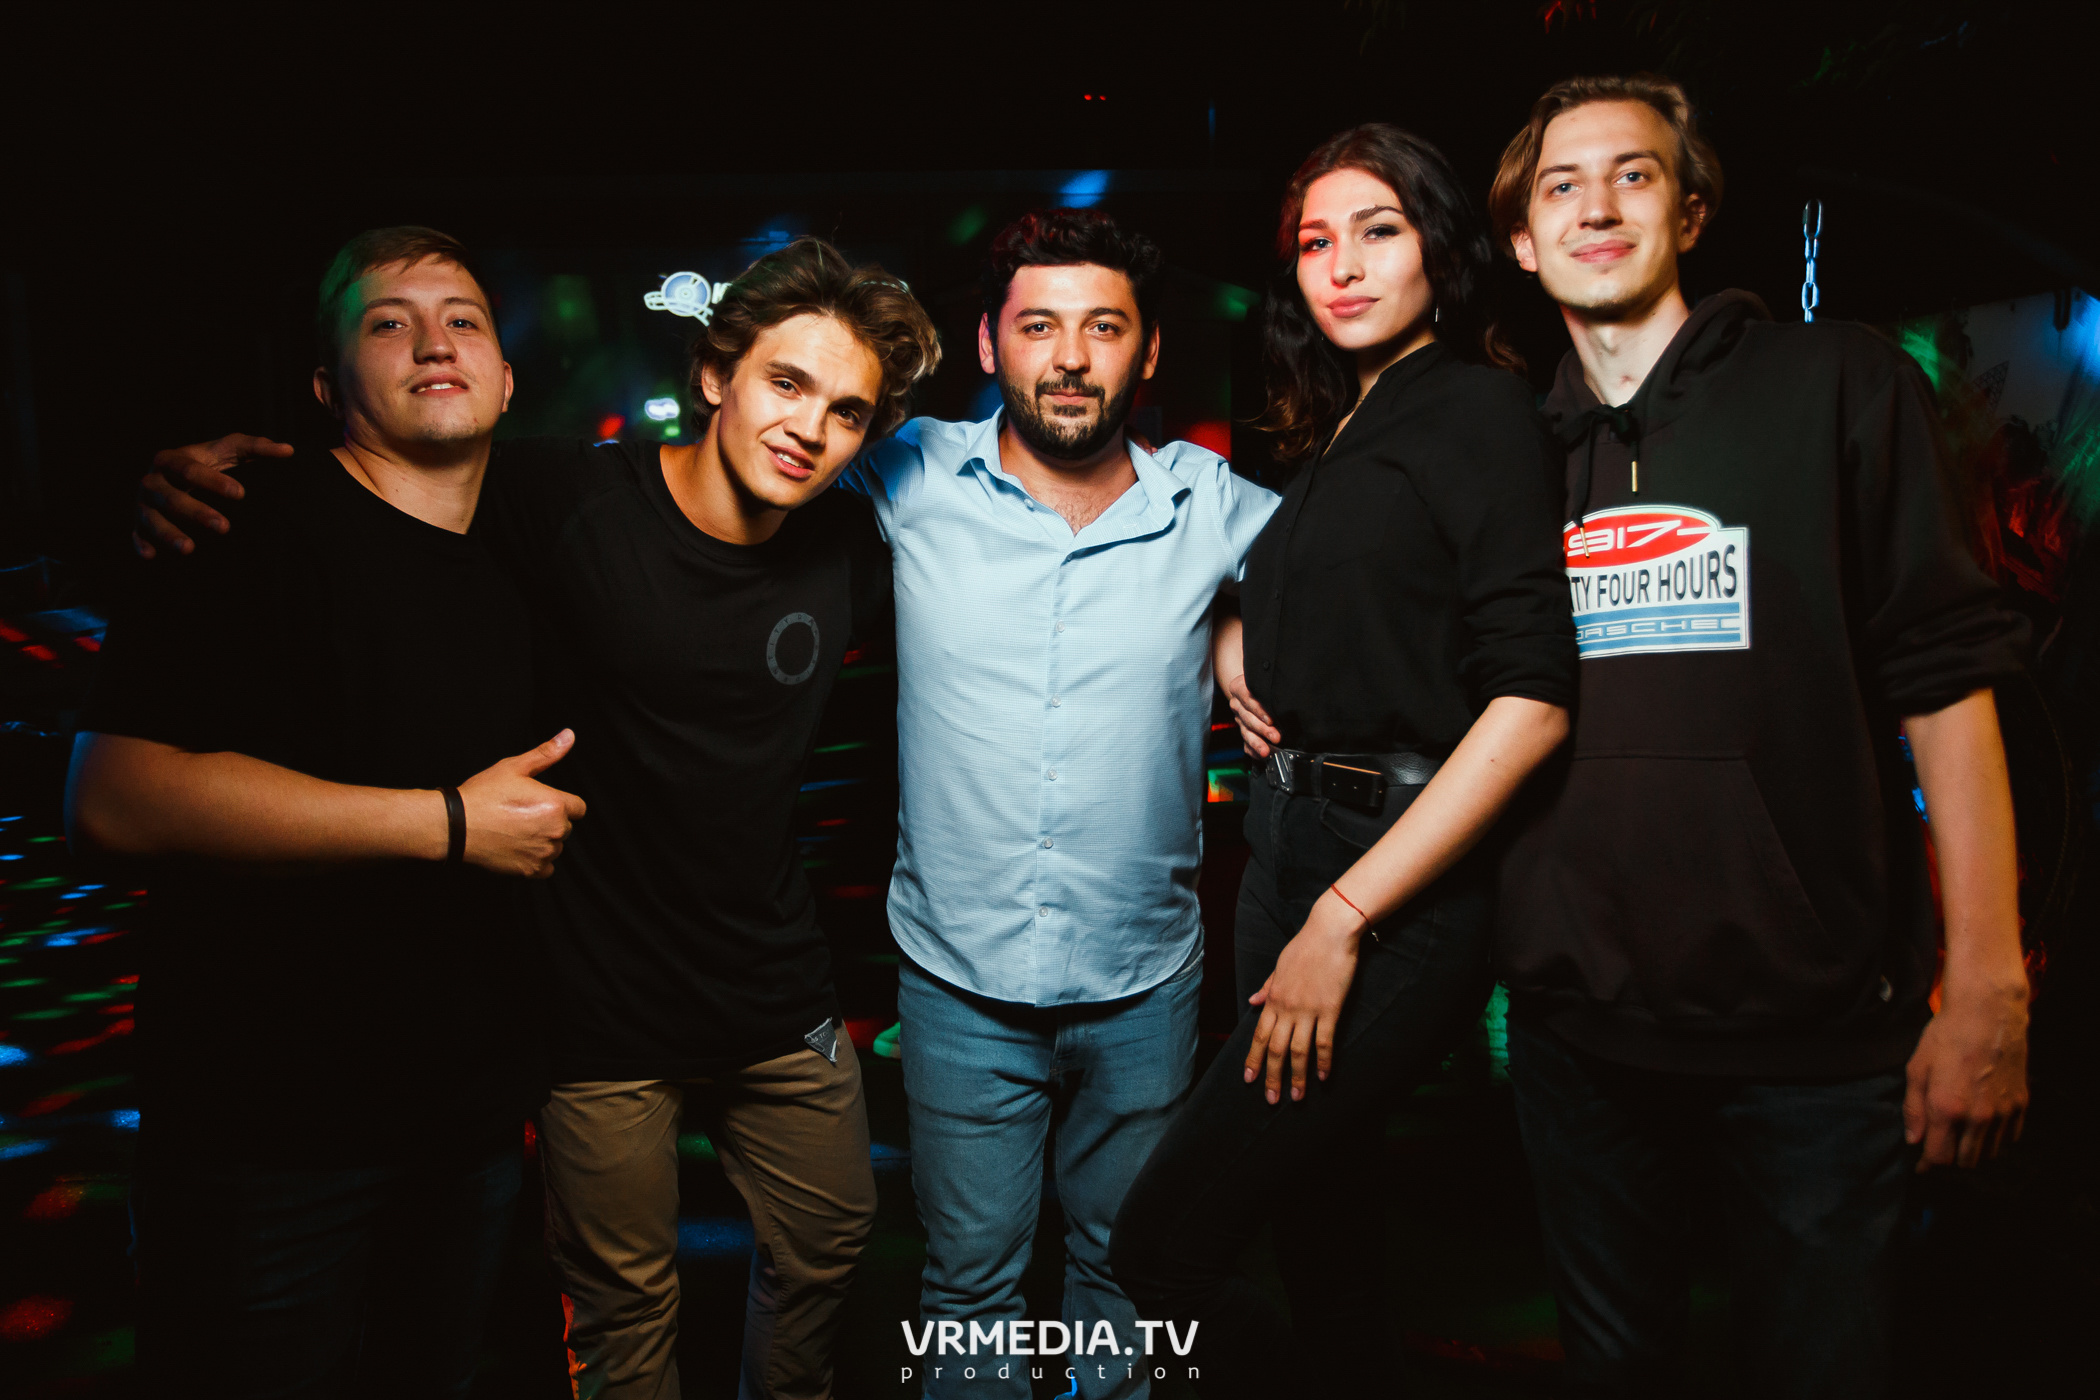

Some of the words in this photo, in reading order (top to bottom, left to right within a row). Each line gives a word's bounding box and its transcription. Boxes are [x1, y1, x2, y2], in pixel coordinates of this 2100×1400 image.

[1570, 575, 1591, 612] TY
[1597, 569, 1650, 608] FOUR
[1657, 544, 1737, 602] HOURS
